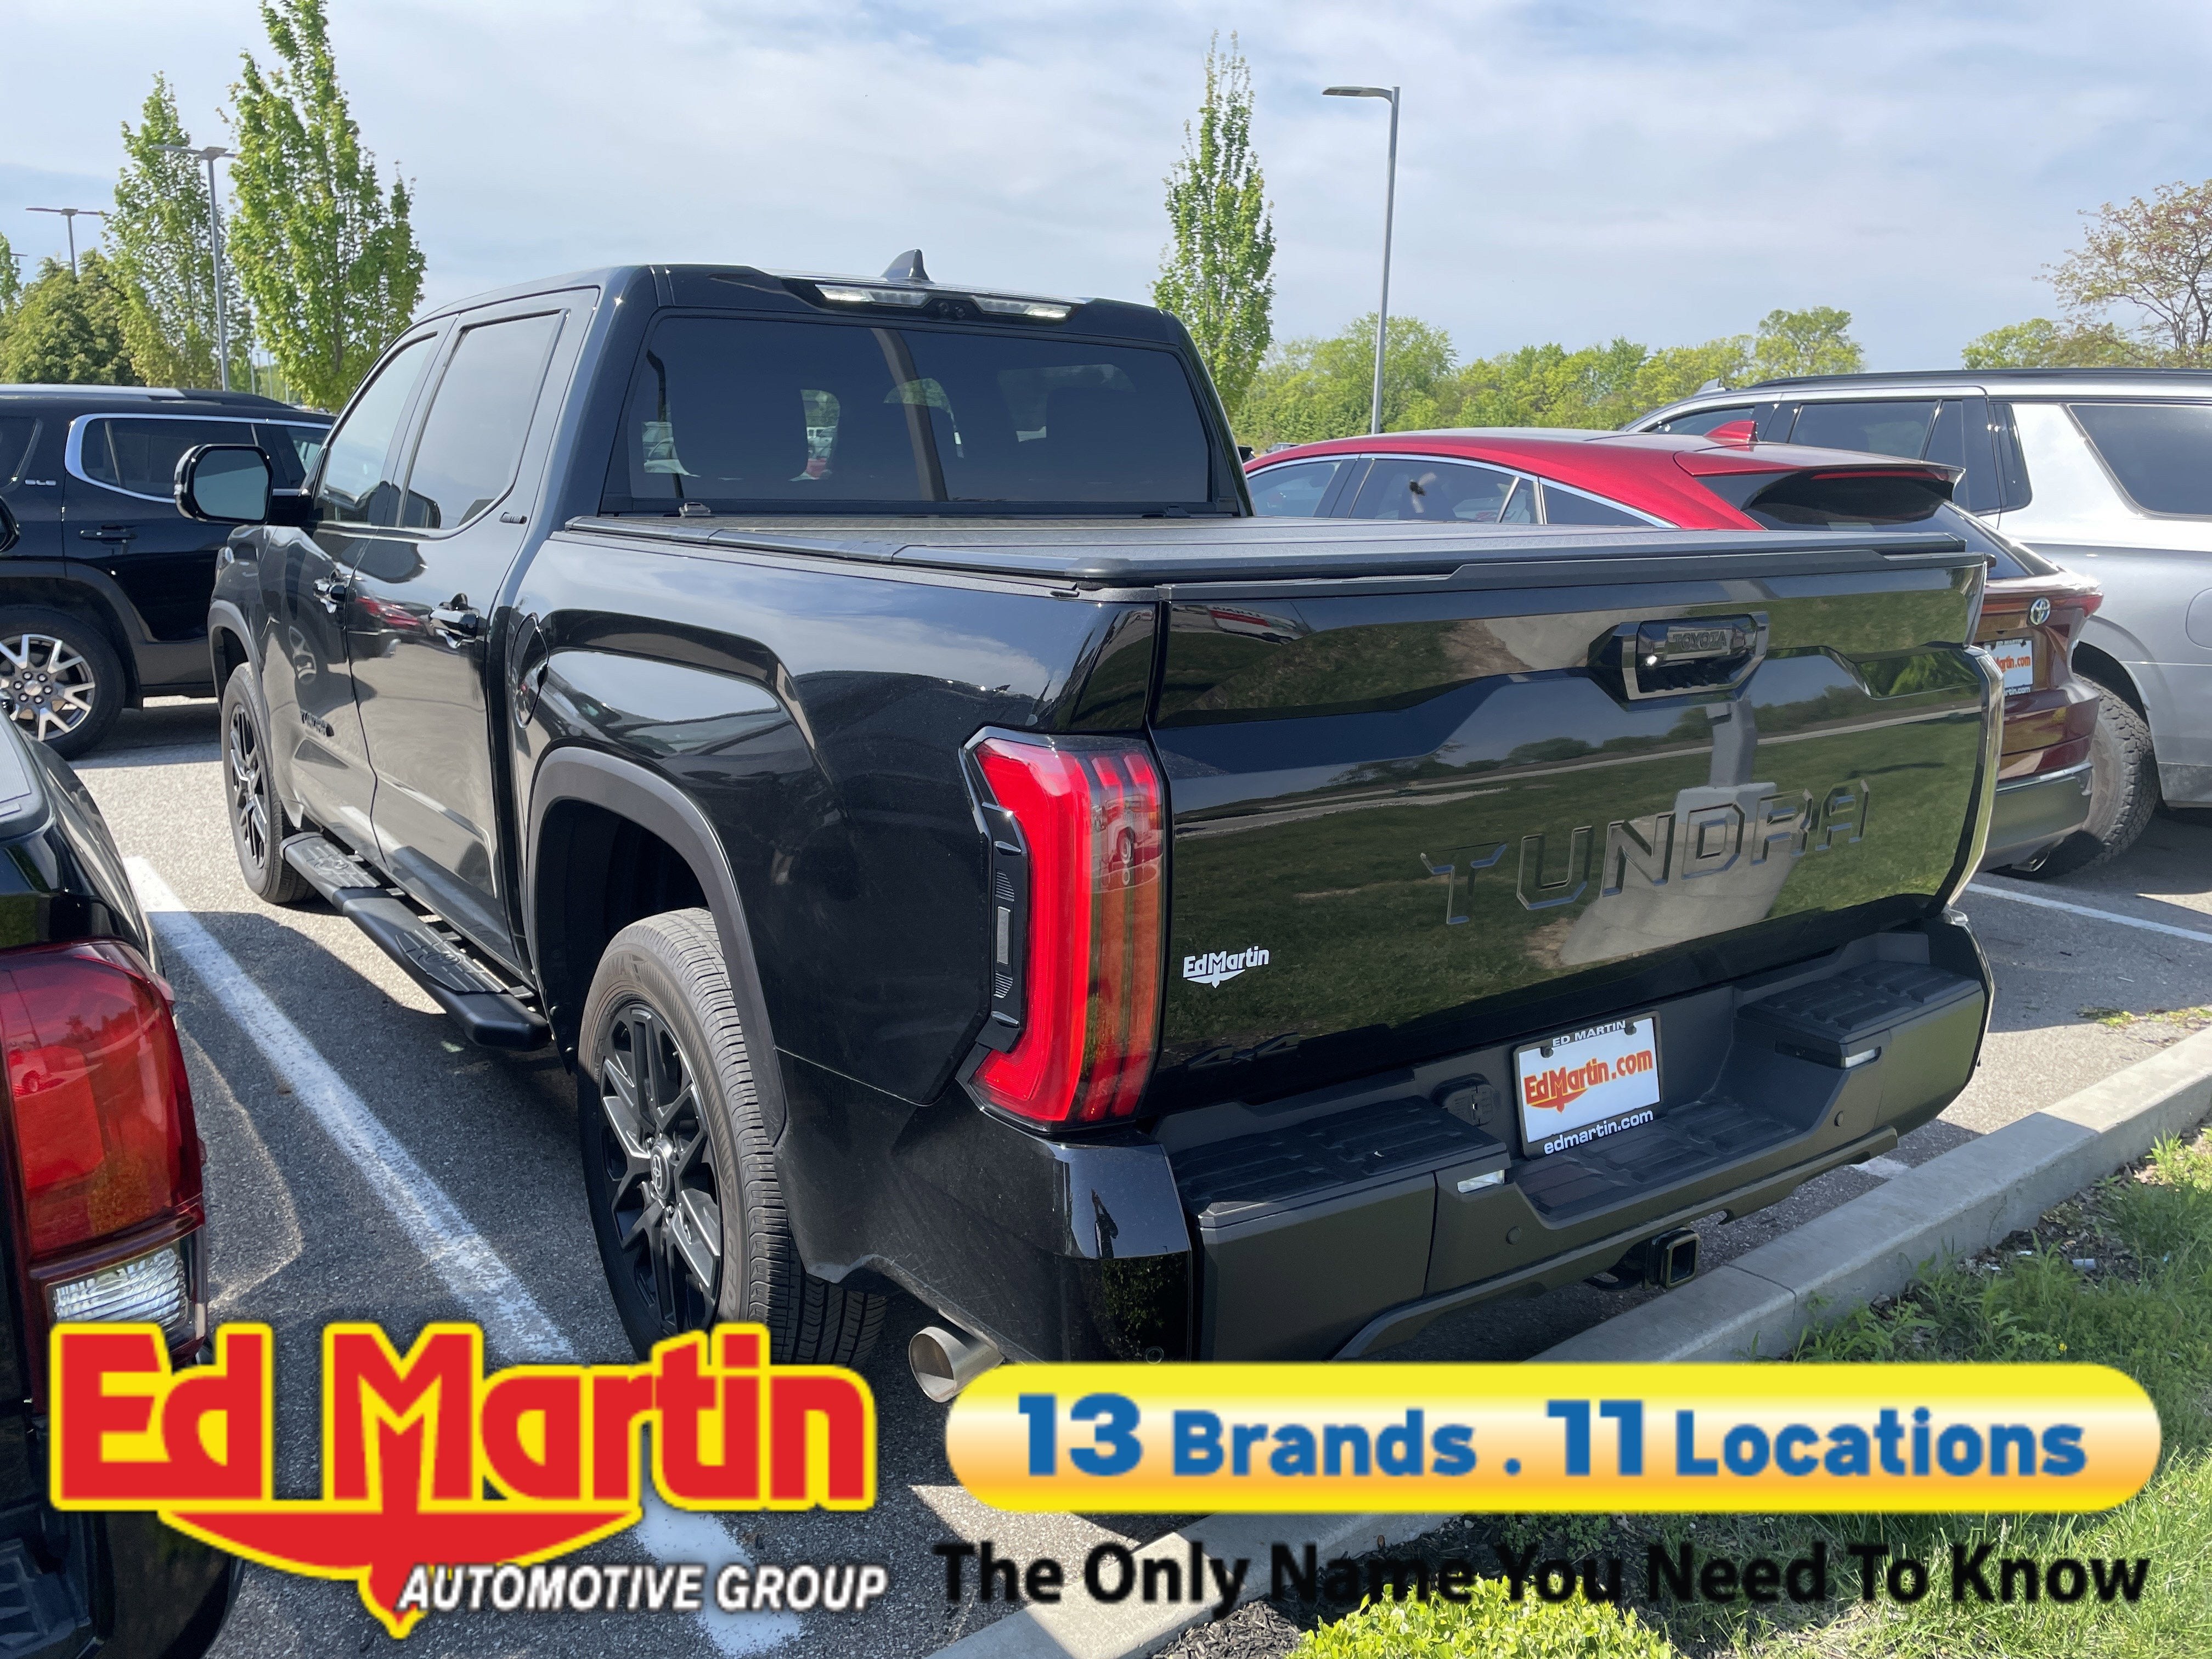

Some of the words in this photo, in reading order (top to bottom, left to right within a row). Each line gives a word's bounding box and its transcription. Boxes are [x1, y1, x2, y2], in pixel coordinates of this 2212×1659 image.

[1673, 630, 1728, 651] TOYOTA
[1420, 778, 1870, 925] TUNDRA
[1183, 945, 1269, 979] EdMartin
[1552, 1035, 1571, 1047] ED
[1574, 1020, 1626, 1042] MARTIN
[1523, 1049, 1654, 1105] EdMartin.com
[1543, 1109, 1654, 1154] edmartin.com
